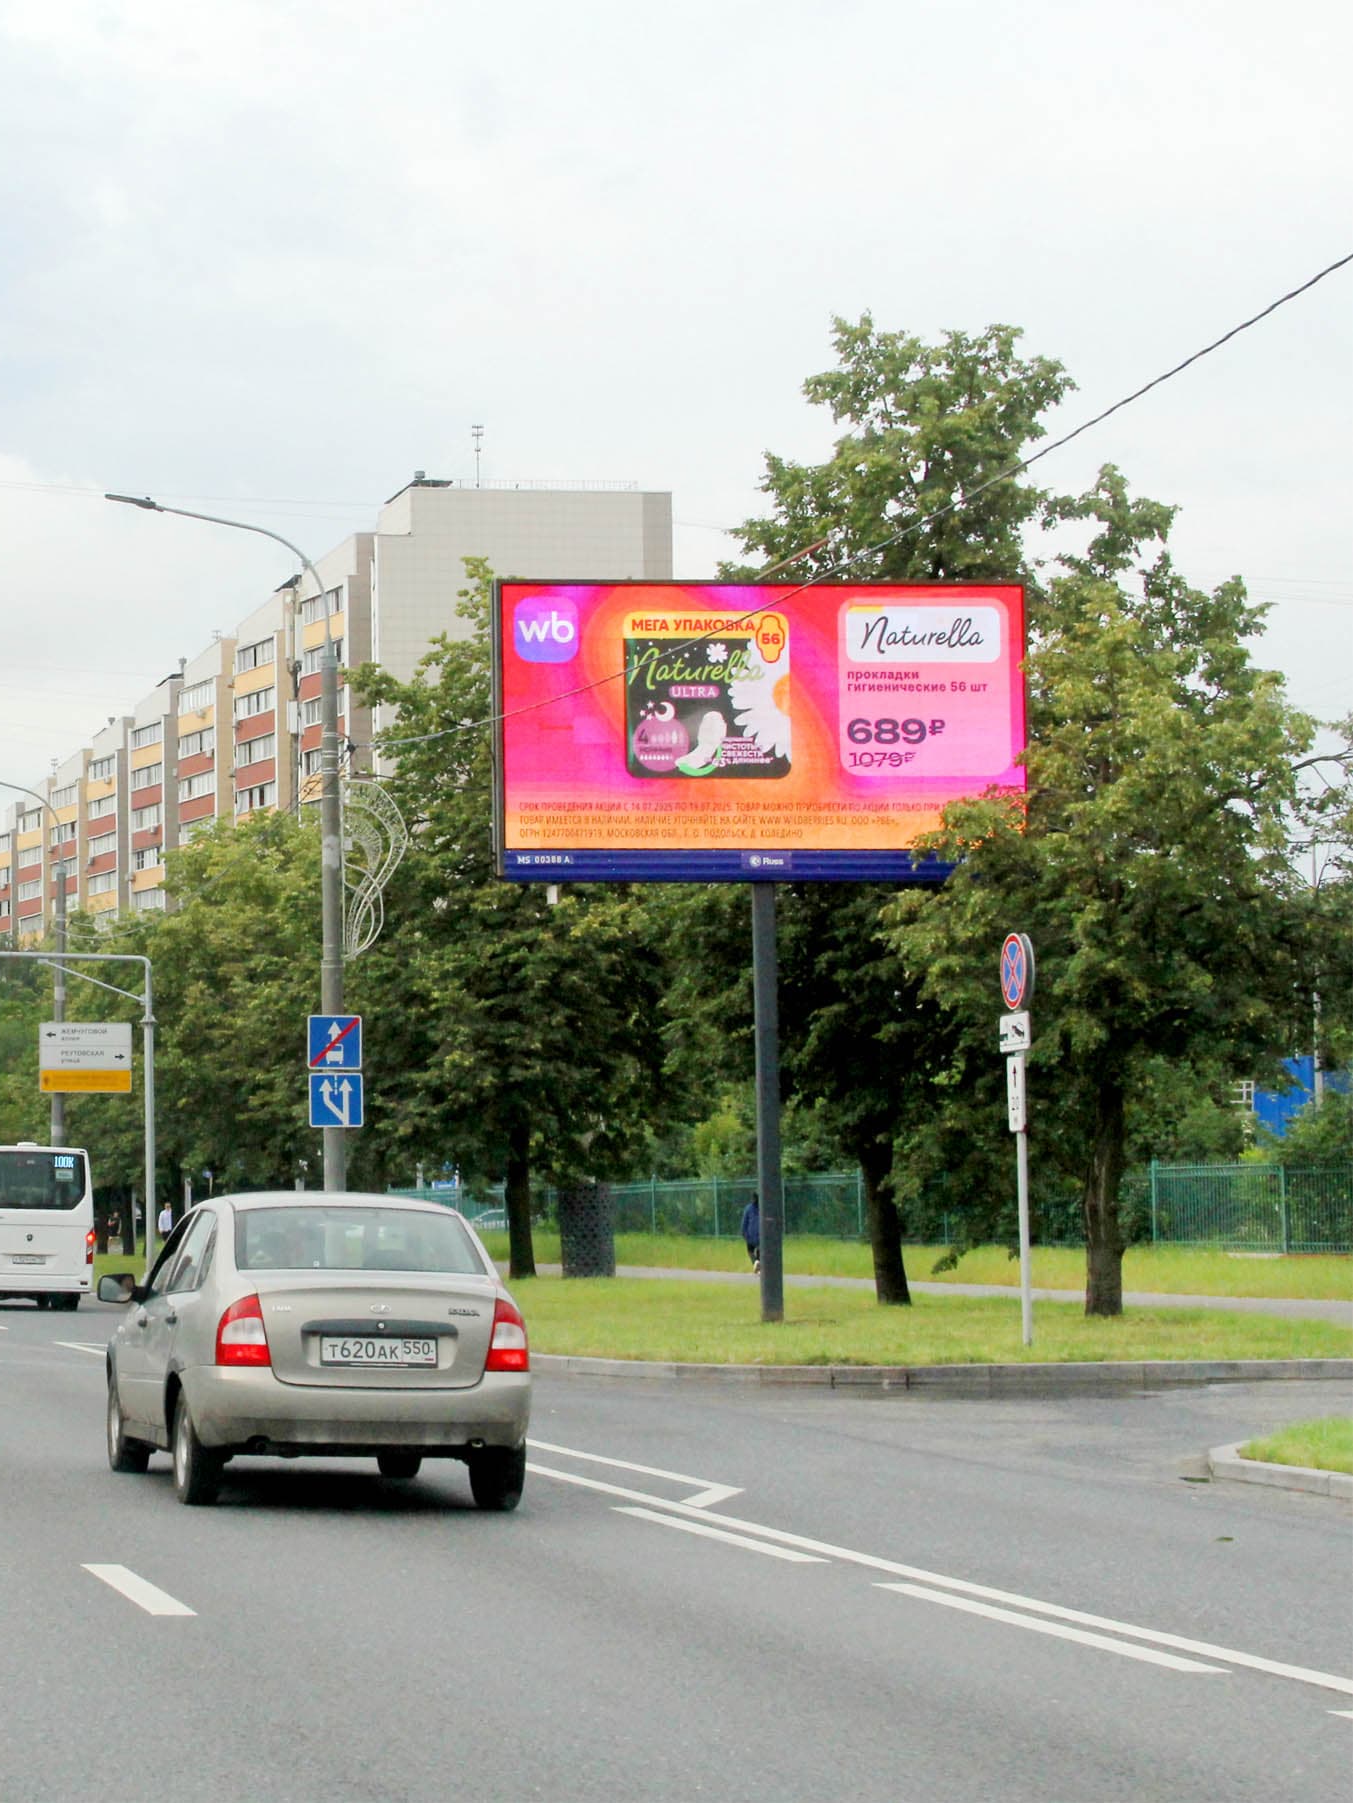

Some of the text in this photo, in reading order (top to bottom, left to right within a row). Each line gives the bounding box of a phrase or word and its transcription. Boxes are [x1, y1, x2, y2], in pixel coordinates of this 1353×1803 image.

[518, 611, 574, 644] wb
[631, 619, 755, 631] МЕГА УПАКОВКА
[762, 633, 780, 645] 56
[860, 616, 984, 655] Naturella
[628, 647, 765, 690] Naturella
[847, 671, 919, 681] прокладки
[672, 686, 717, 698] ULTRA
[847, 681, 988, 692] гигиенические 56 шт
[847, 718, 946, 745] 689₽
[519, 802, 539, 812] СРОК
[736, 802, 760, 812] ТОВАР
[763, 802, 795, 812] МОЖНО
[519, 815, 544, 825] ТОВАР
[547, 815, 582, 825] ИМЕЕТСЯ
[634, 815, 671, 825] НАЛИЧИЕ
[673, 815, 716, 825] УТОЧНЯЙТЕ
[720, 815, 731, 825] НА
[733, 815, 756, 825] САЙТЕ
[852, 815, 869, 825] ООО
[607, 828, 659, 838] МОСКОВСКАЯ
[763, 857, 784, 865] Russ
[328, 1341, 430, 1359] Т620АК 550
